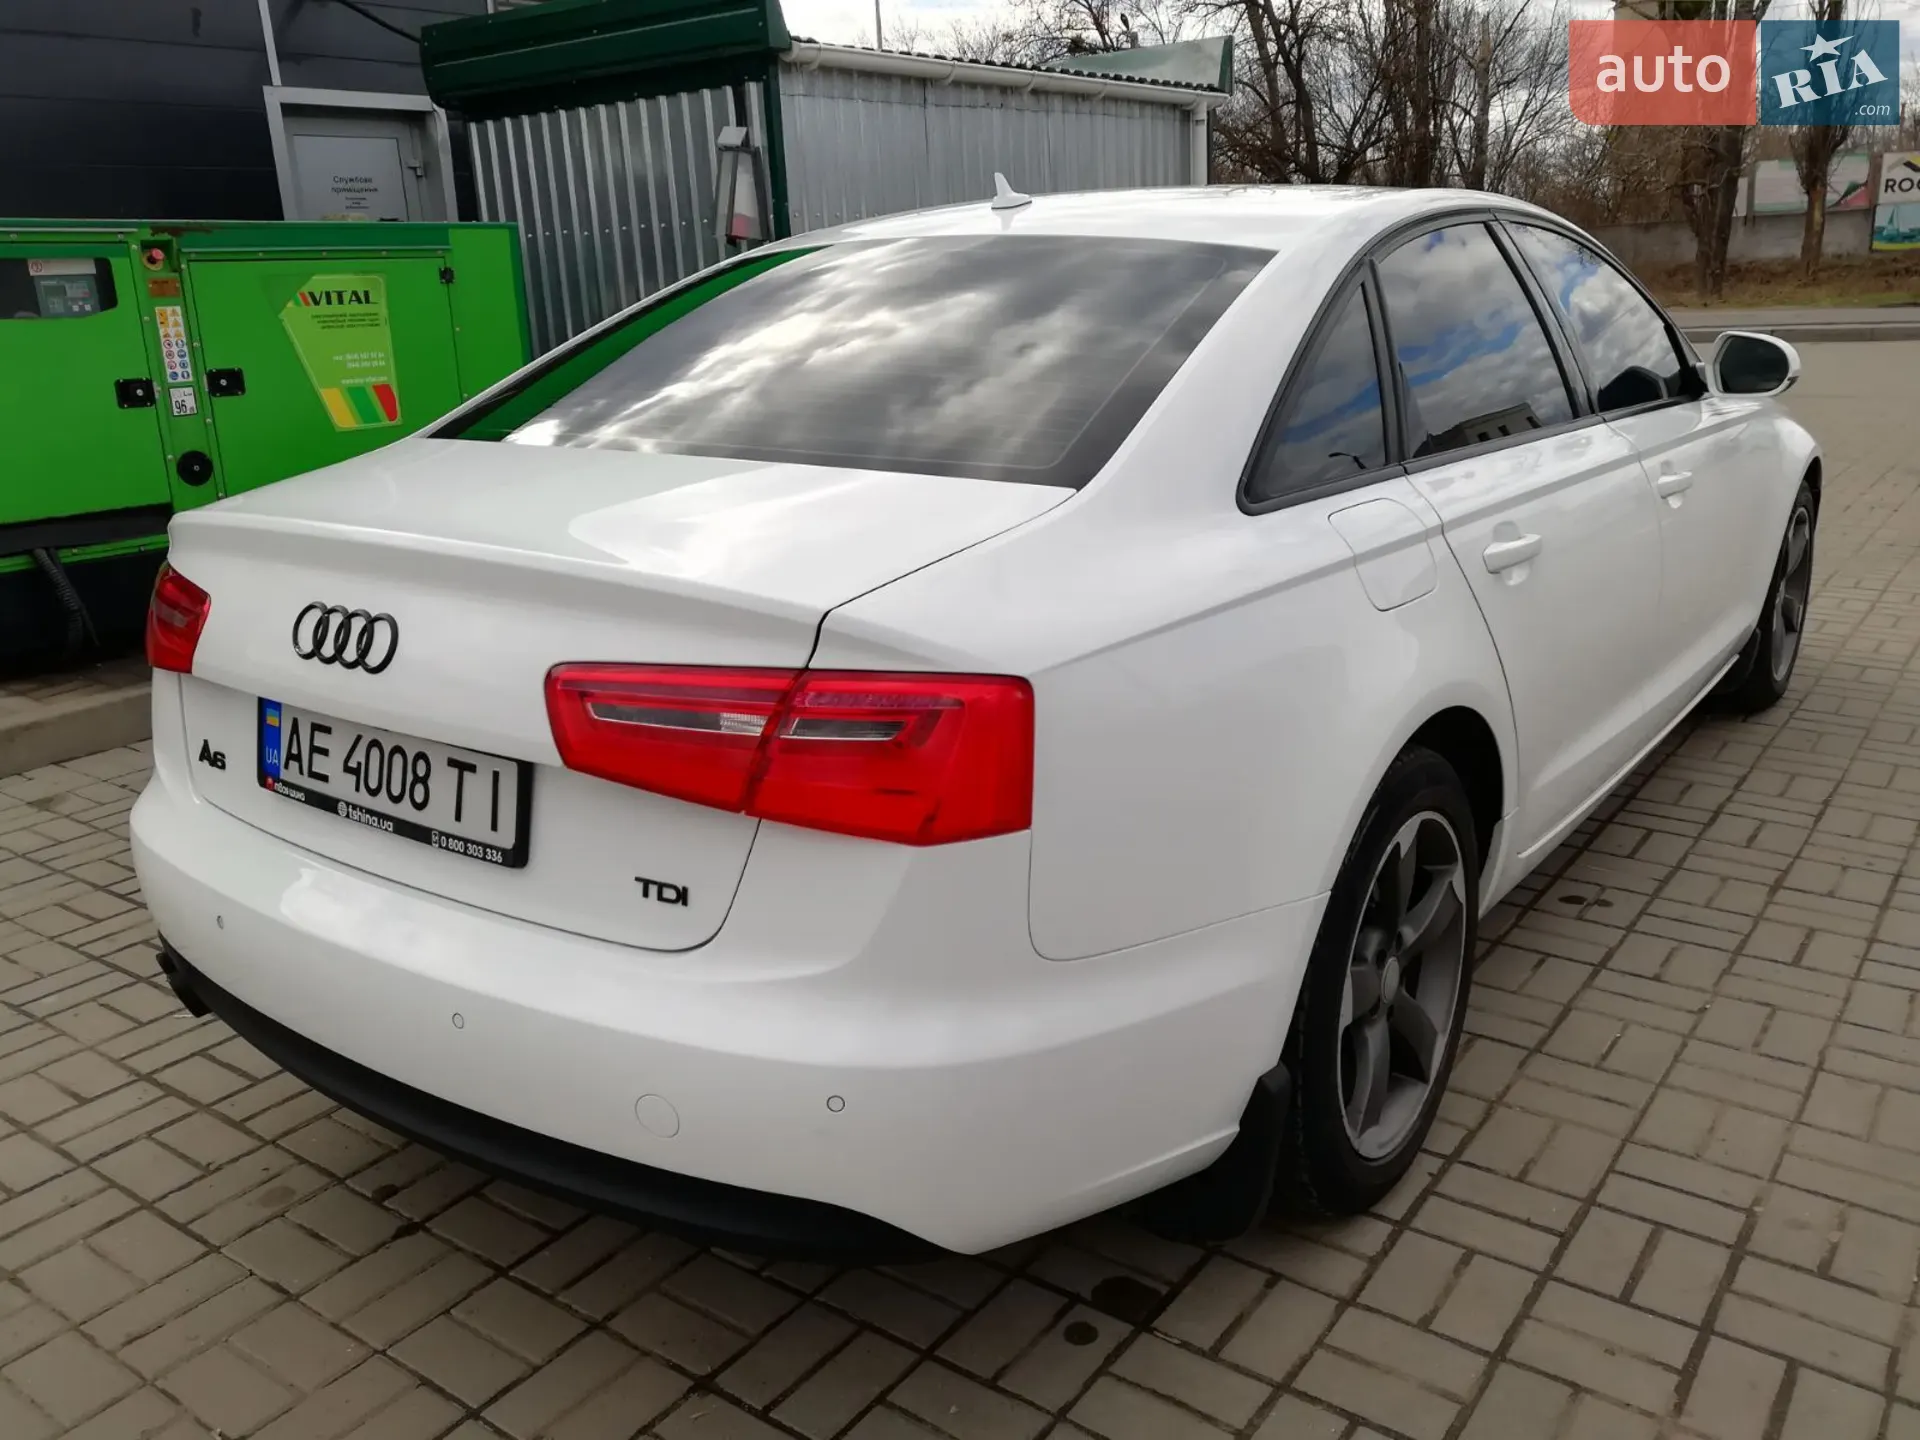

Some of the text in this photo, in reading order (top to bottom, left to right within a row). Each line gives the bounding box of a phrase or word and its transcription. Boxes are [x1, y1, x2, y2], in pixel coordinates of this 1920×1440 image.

[308, 289, 379, 307] VITAL
[175, 399, 188, 414] 96
[199, 739, 226, 770] A6
[265, 746, 279, 766] UA
[284, 716, 499, 832] AE 4008 TI
[348, 804, 394, 832] tshina.ua
[440, 835, 503, 863] 0 800 303 336
[634, 876, 689, 907] TDI
